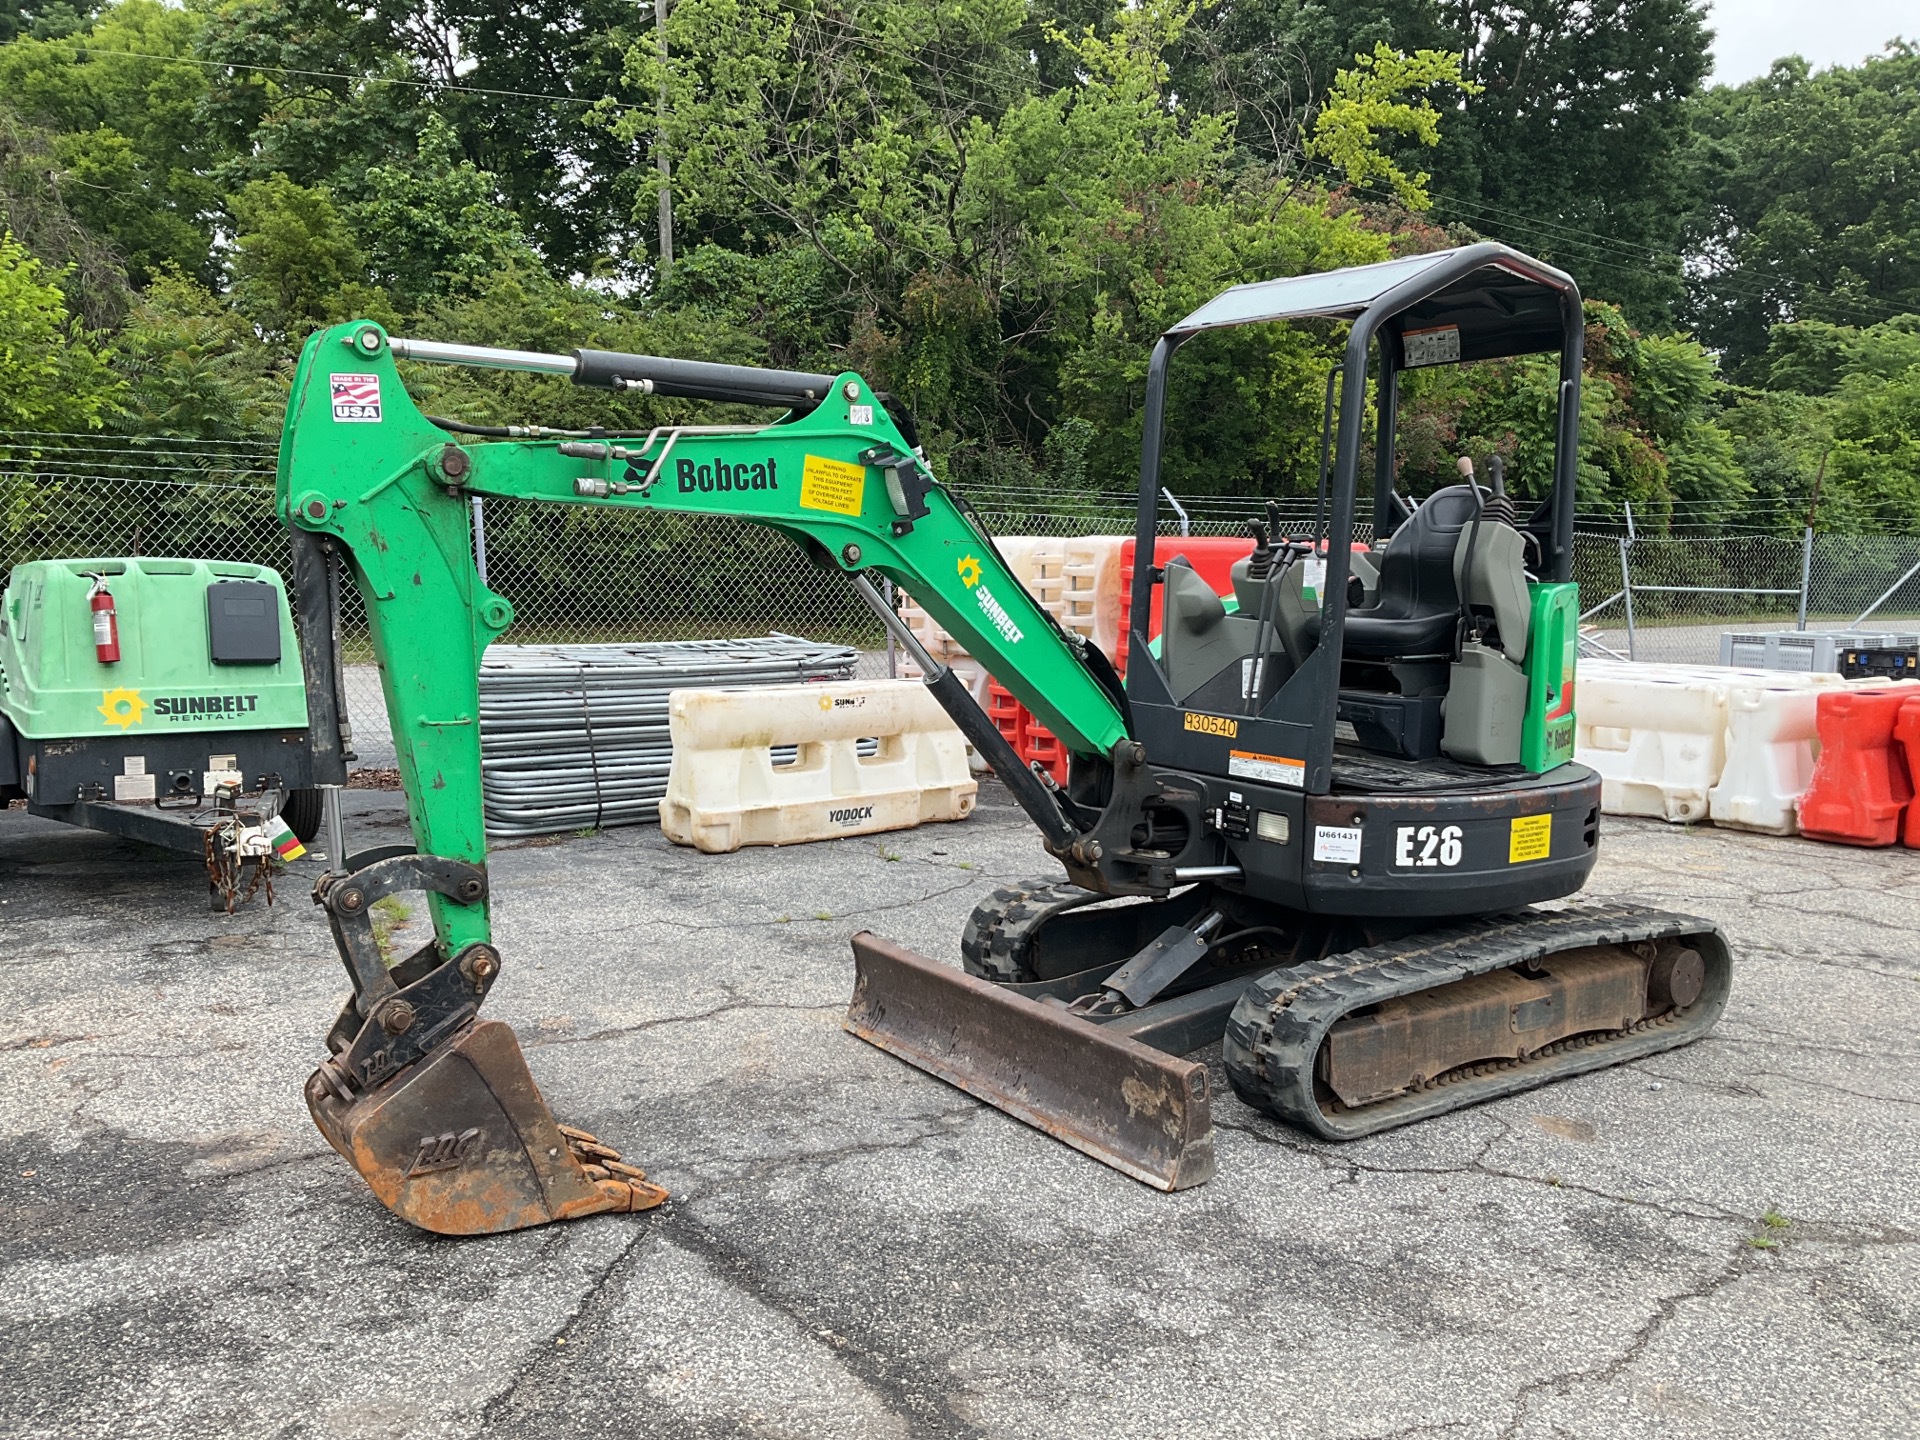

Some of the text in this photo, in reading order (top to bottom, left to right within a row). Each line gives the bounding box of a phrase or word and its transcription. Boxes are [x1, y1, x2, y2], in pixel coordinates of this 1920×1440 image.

[335, 406, 378, 418] USA
[676, 457, 778, 493] Bobcat
[806, 468, 831, 477] UNLAWFUL
[840, 474, 862, 483] OPERATE
[823, 464, 846, 472] WARNING
[812, 483, 829, 491] WITHIN
[826, 479, 853, 488] EQUIPMENT
[813, 498, 834, 506] VOLTAGE
[816, 491, 842, 500] OVERHEAD
[975, 585, 1024, 644] SUNBELT
[978, 601, 1011, 642] RENTALS
[153, 695, 258, 715] SUNBELT
[1185, 713, 1236, 736] 930540
[829, 806, 873, 822] YODOCK
[1319, 831, 1358, 840] U661431
[1395, 825, 1463, 866] E26
